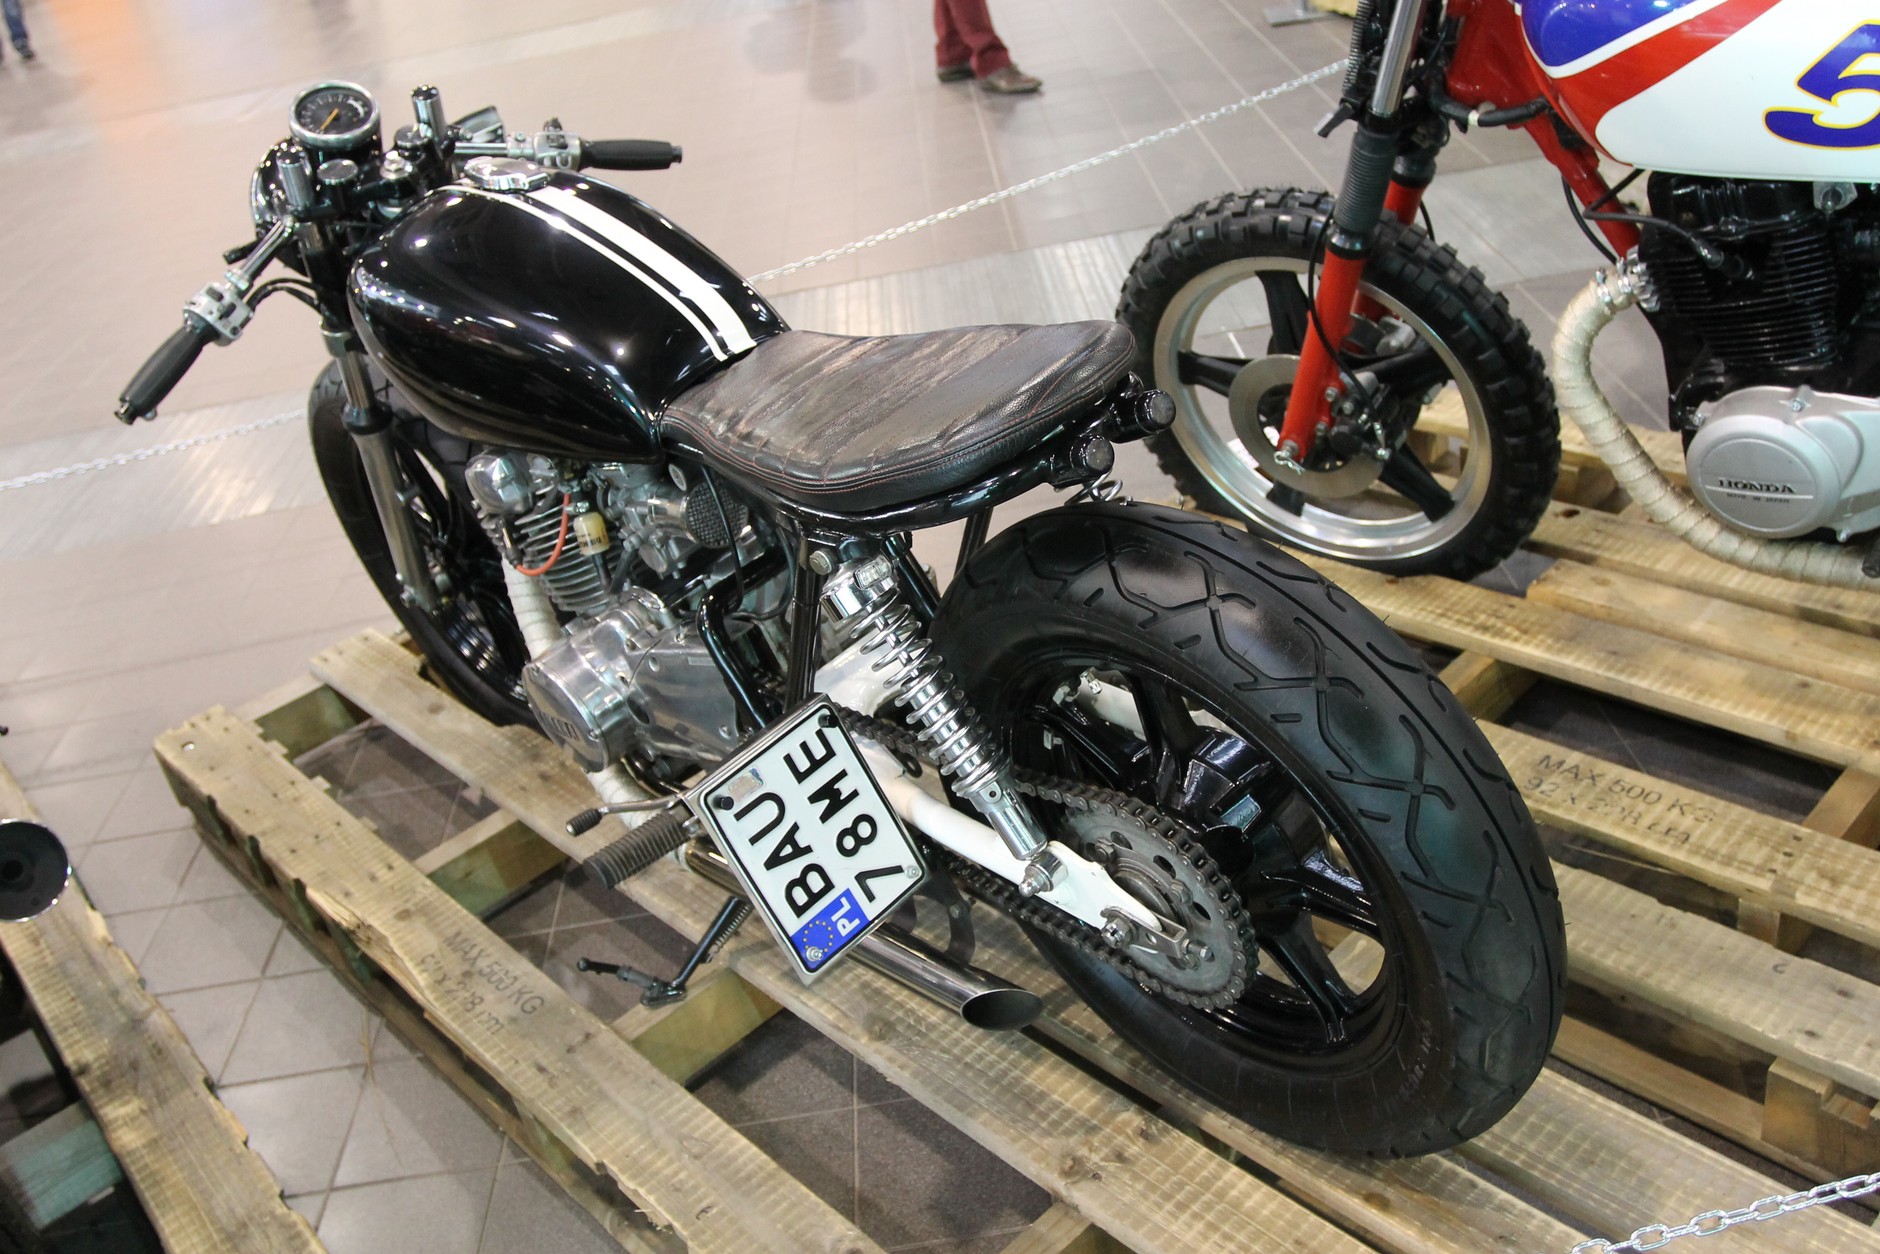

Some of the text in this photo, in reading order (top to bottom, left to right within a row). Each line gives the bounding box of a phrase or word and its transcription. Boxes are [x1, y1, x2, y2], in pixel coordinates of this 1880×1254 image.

[1718, 478, 1795, 494] HONDA
[1523, 776, 1559, 798] 92
[1537, 755, 1604, 786] MAX
[1608, 779, 1663, 805] 500
[783, 728, 904, 903] 78ME
[733, 791, 836, 919] BAU
[837, 896, 860, 937] PL
[443, 931, 545, 1015] MAX 500 KG
